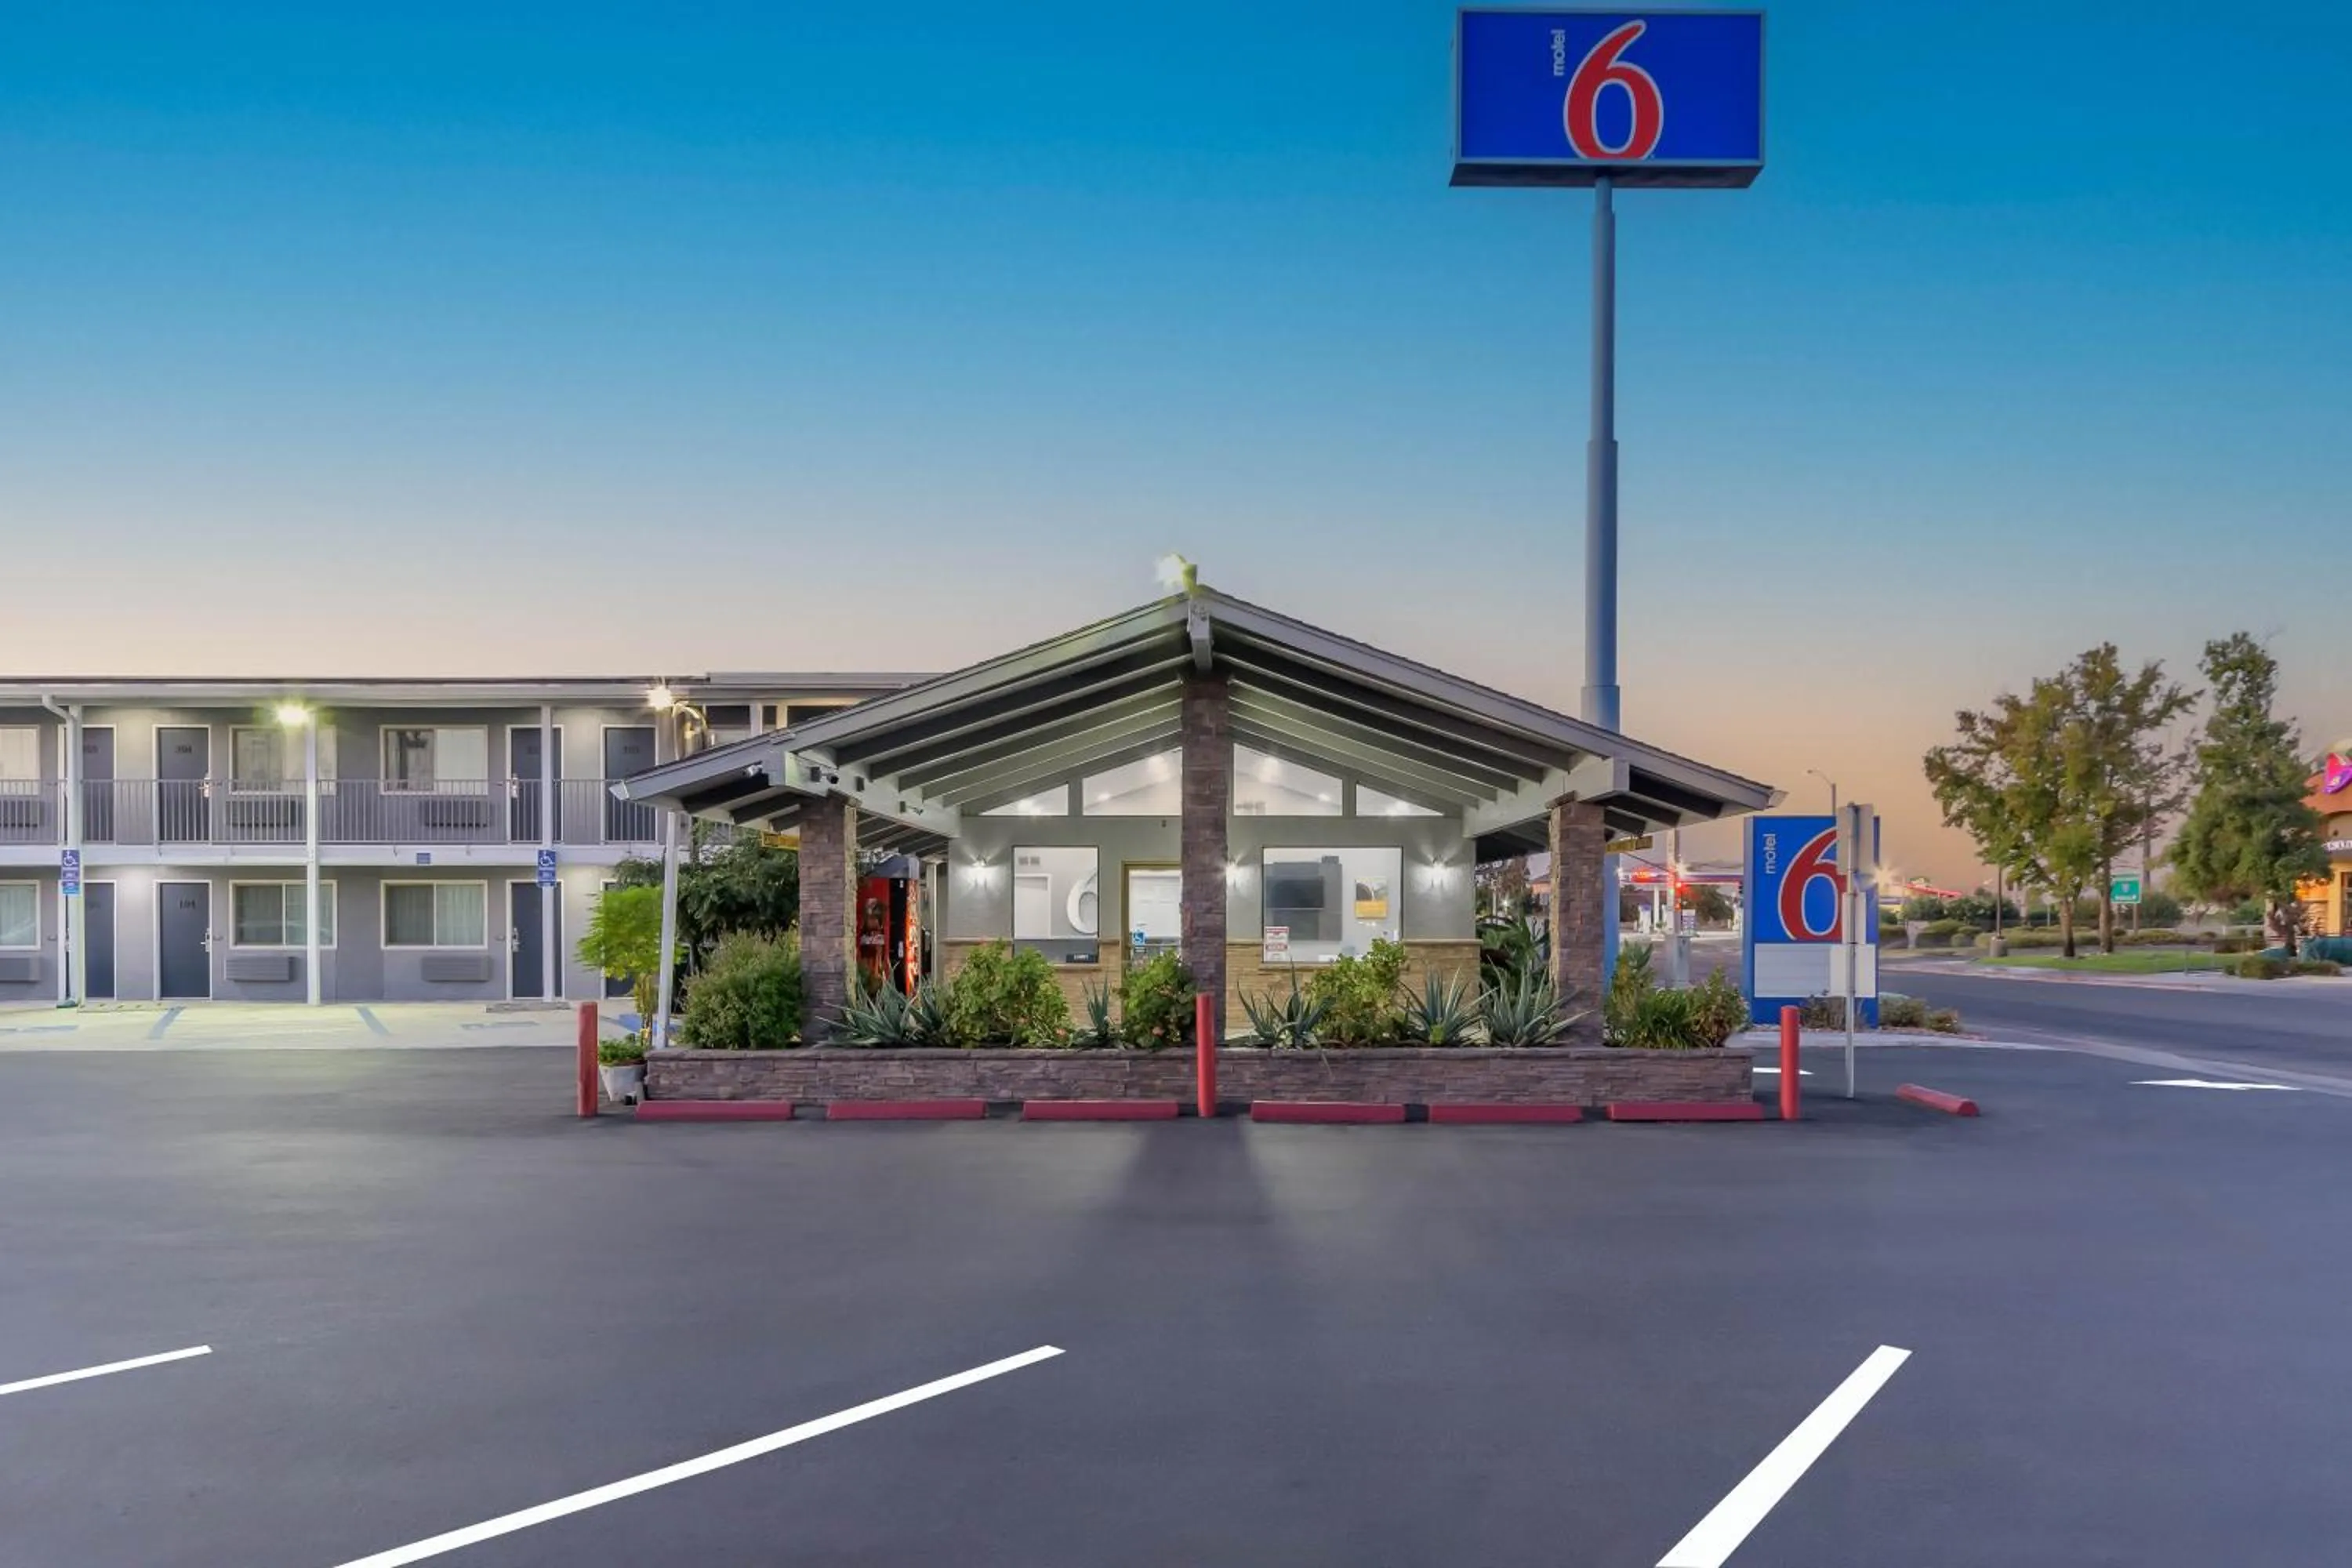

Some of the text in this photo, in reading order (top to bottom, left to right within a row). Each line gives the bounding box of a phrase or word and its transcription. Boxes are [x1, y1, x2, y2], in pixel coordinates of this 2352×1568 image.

[1551, 29, 1566, 76] motel
[1563, 19, 1664, 161] 6
[1762, 833, 1777, 874] motel
[1777, 826, 1848, 941] 6
